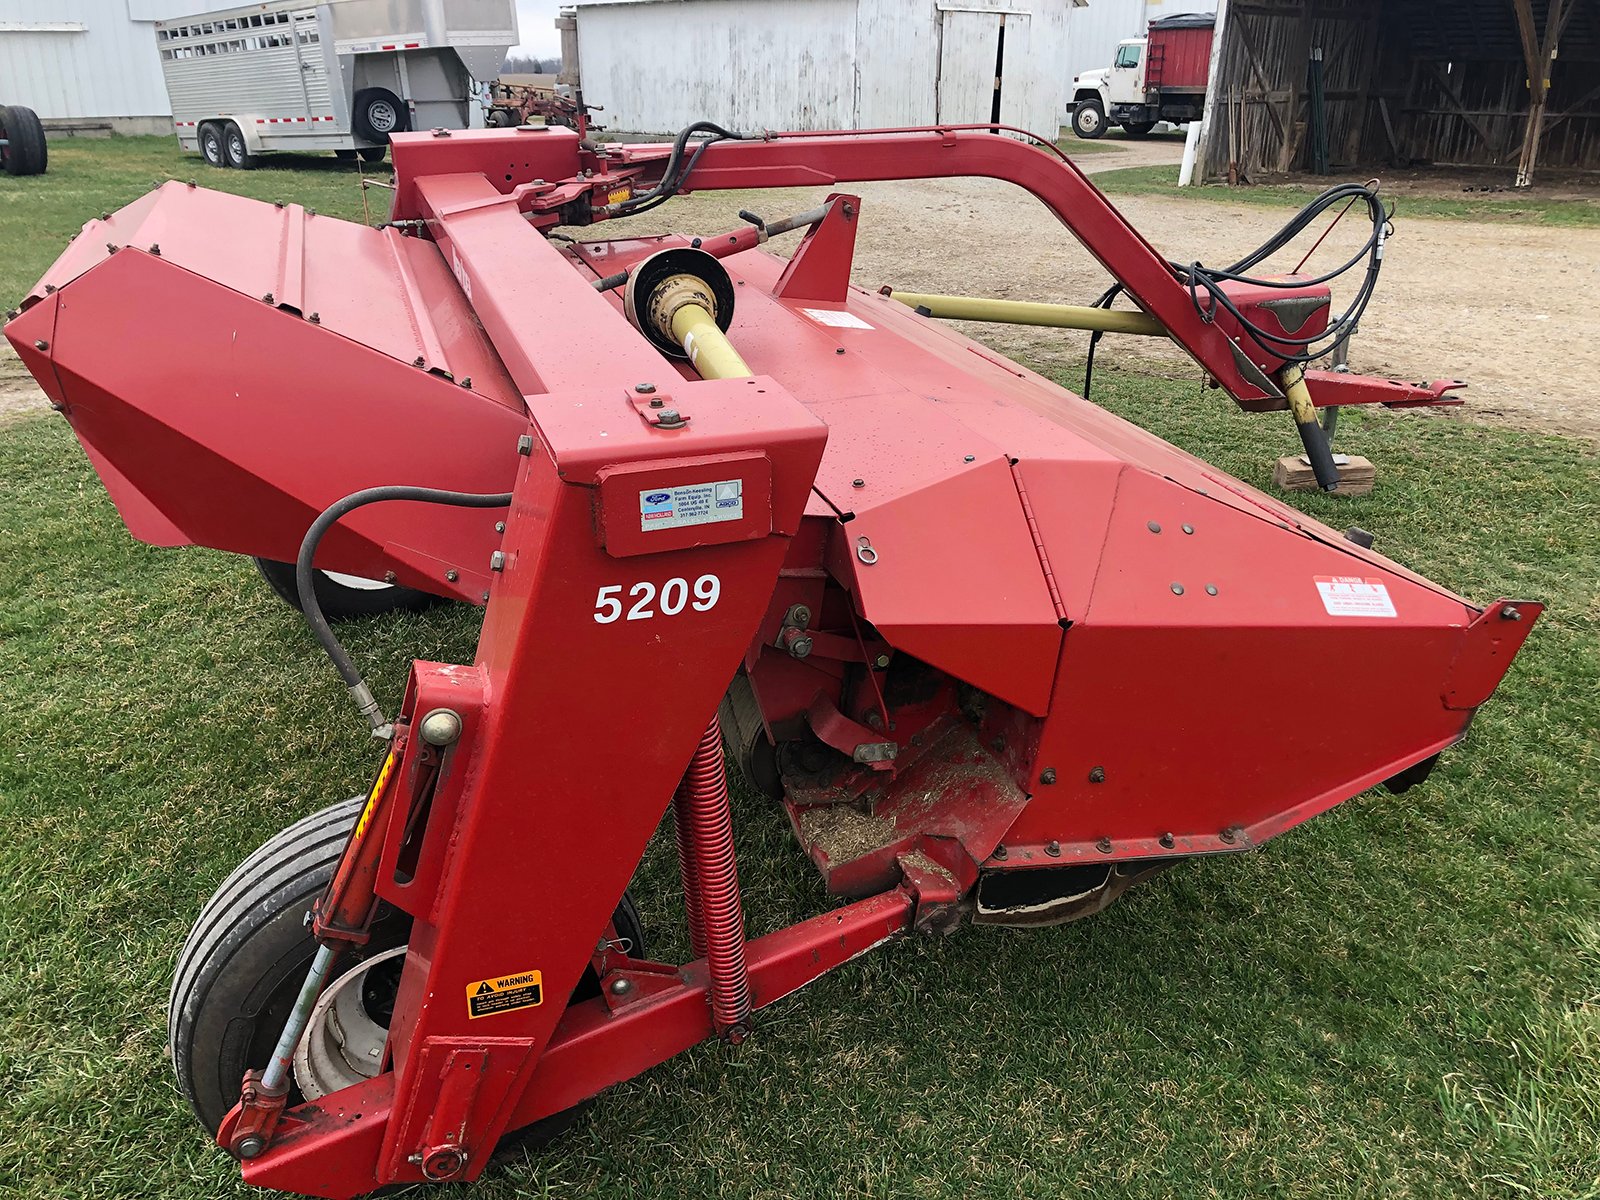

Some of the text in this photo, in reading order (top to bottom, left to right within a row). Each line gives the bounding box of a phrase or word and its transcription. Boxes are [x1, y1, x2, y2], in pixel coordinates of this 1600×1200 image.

[718, 500, 737, 508] AGCO
[593, 574, 721, 624] 5209
[497, 974, 534, 988] WARNING
